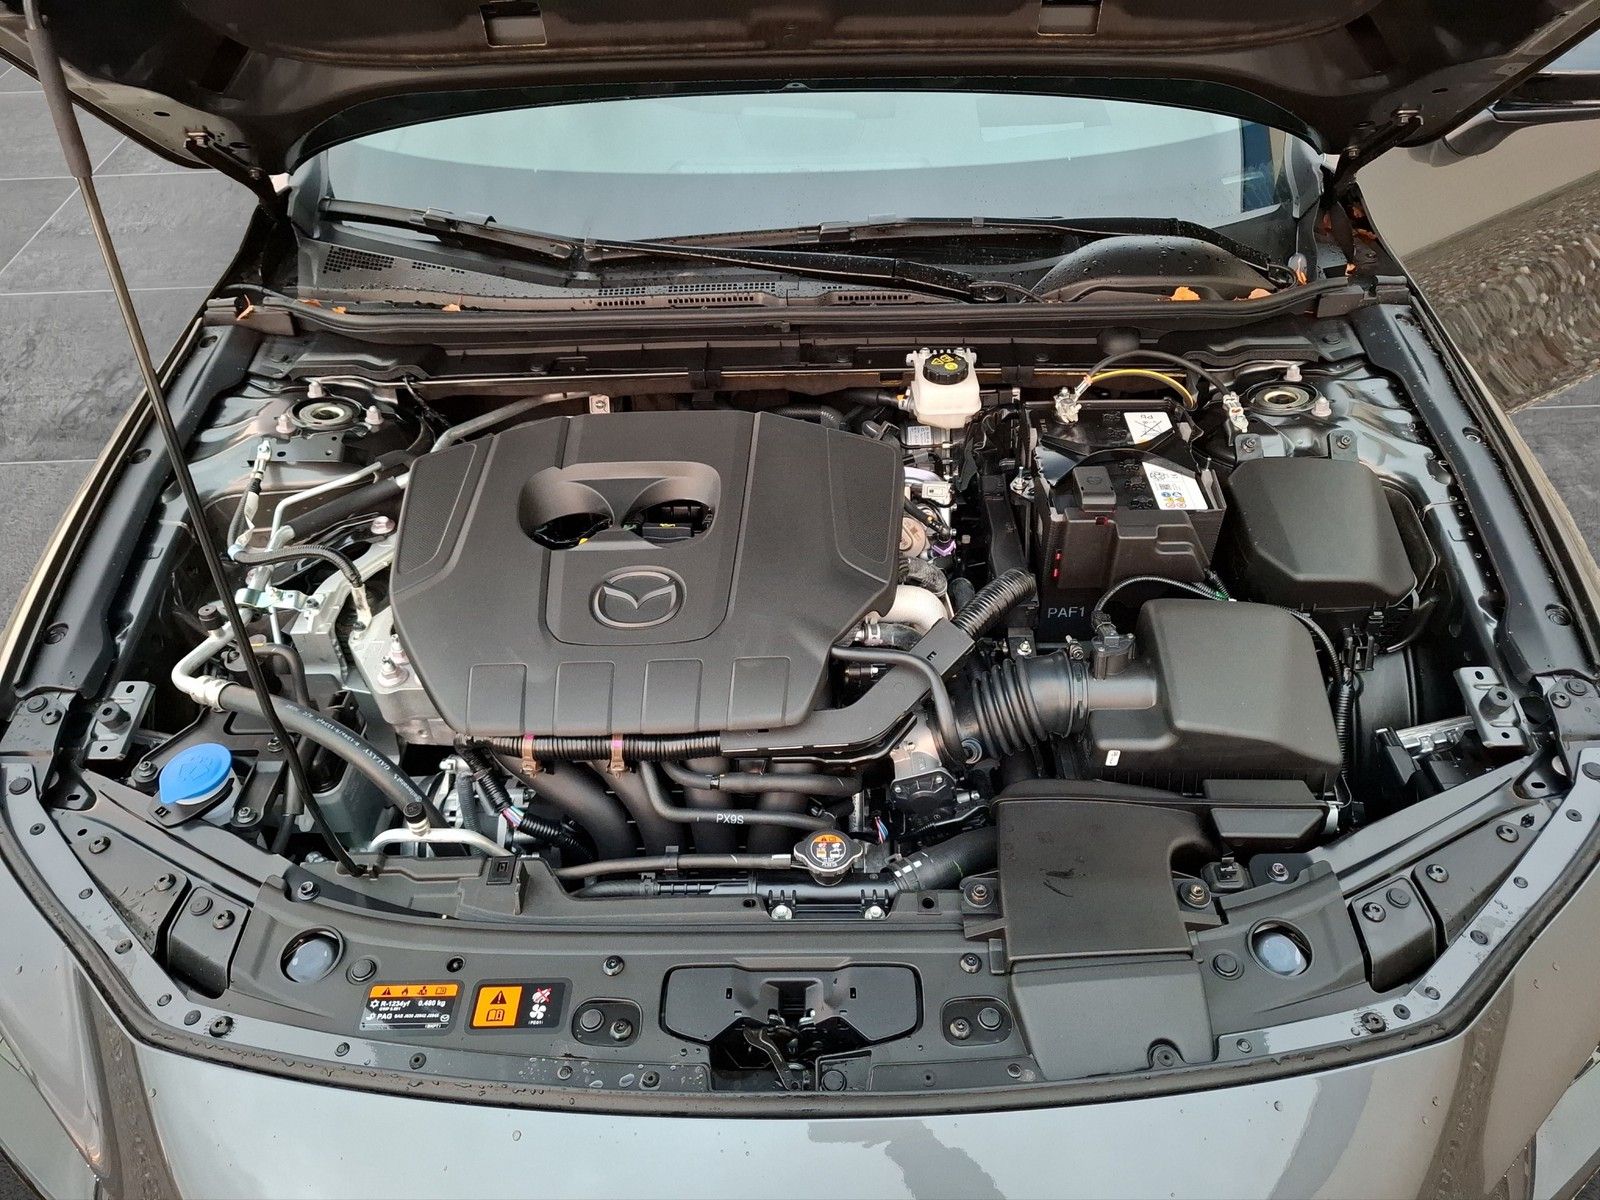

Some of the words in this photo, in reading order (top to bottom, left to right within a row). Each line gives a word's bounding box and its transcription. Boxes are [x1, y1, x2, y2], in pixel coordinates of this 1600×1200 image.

[1047, 606, 1085, 619] PAF1
[363, 748, 391, 771] GALAXY
[716, 813, 744, 825] PX9S
[437, 1000, 446, 1008] kg
